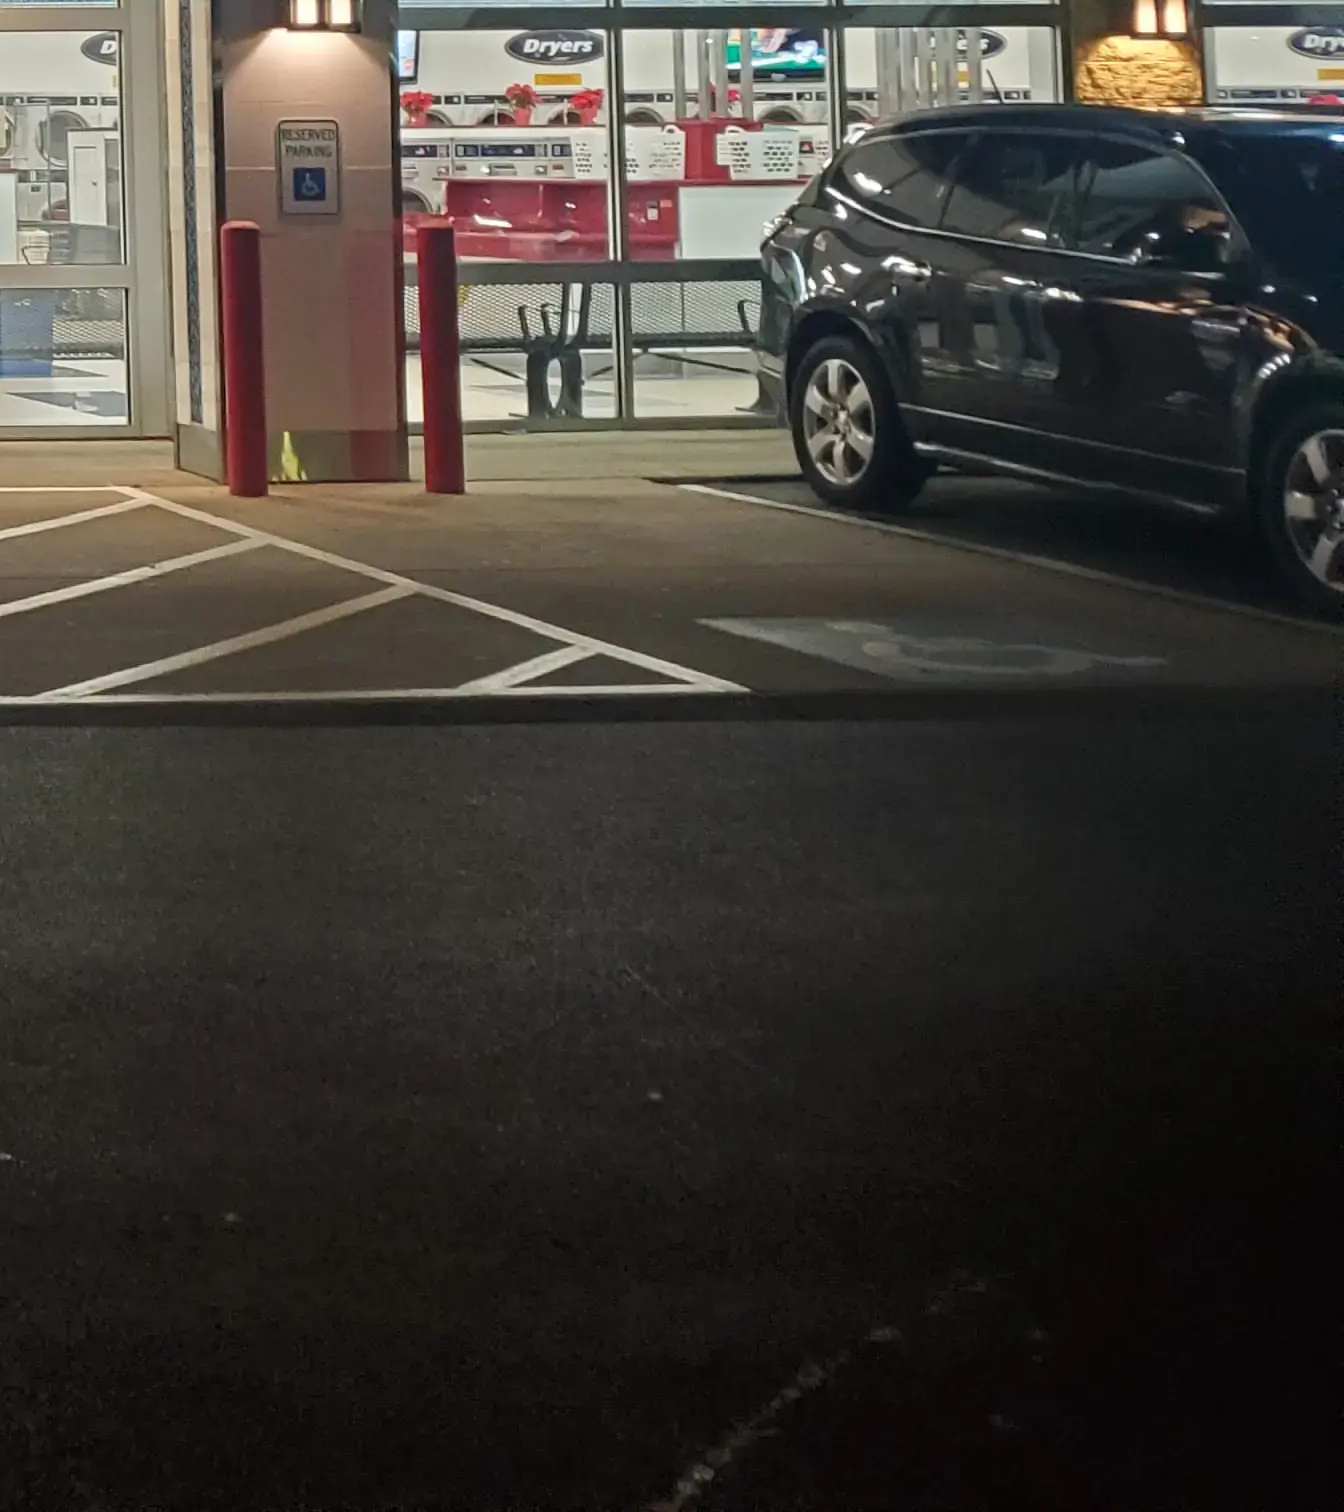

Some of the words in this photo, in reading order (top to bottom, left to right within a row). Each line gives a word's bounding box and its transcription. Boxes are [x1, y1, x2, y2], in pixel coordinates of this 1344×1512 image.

[523, 38, 594, 57] Dryers
[282, 128, 336, 141] RESERVED
[285, 144, 333, 158] PARKING
